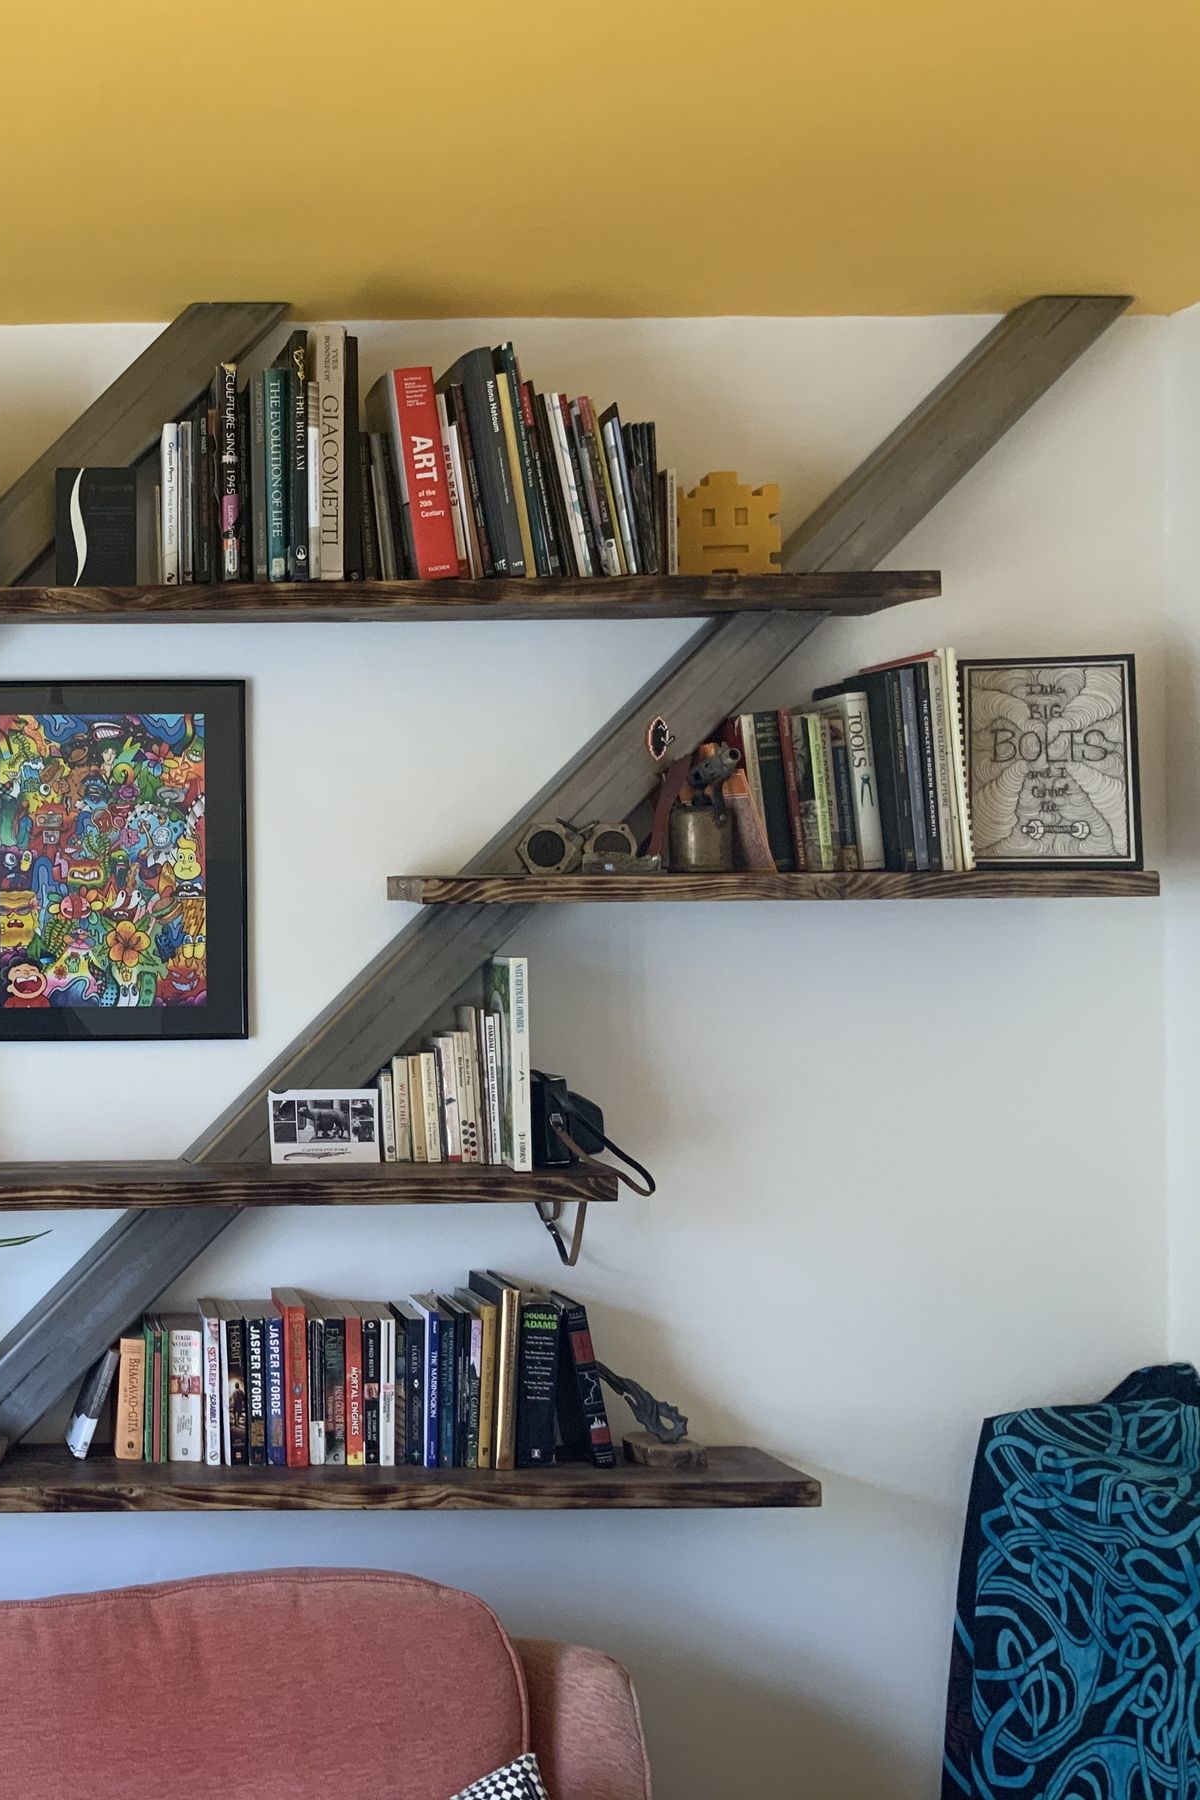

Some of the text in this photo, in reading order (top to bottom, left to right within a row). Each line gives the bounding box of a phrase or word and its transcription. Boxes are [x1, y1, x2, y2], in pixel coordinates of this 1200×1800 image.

[486, 380, 500, 433] Mona Hatoum
[296, 421, 305, 442] BIG
[269, 380, 283, 538] THE EVOLUTION OF LIFE
[296, 452, 305, 471] AM
[321, 395, 340, 546] GIACOMETTI
[410, 435, 438, 483] ART
[225, 469, 238, 495] 1945
[419, 499, 433, 508] 20th
[428, 488, 436, 496] the
[420, 508, 445, 518] Century
[427, 564, 450, 573] TASCHEN
[1029, 703, 1065, 720] BIG
[848, 711, 868, 768] TOOLS
[937, 727, 945, 761] WELDED
[990, 729, 1108, 763] BOLTS
[939, 762, 948, 808] SCULPTURE
[1027, 767, 1050, 779] and
[928, 790, 937, 837] BLACKSMITH
[399, 1083, 407, 1129] WEATHER
[523, 1312, 559, 1321] DOUGLAS
[523, 1320, 558, 1330] ADAMS
[228, 1325, 242, 1368] HOBBIT
[250, 1325, 261, 1370] JASPER
[269, 1324, 280, 1368] JASPER
[411, 1345, 419, 1374] HARRIS
[207, 1346, 217, 1424] SEX SLEEP SCRABBLE
[251, 1372, 262, 1417] FFORDE
[270, 1371, 281, 1415] FFORDE
[350, 1366, 359, 1435] MORTAL ENGINES
[470, 1378, 480, 1427] NEIL GAIMAN
[294, 1399, 303, 1447] PHILIP REEVE
